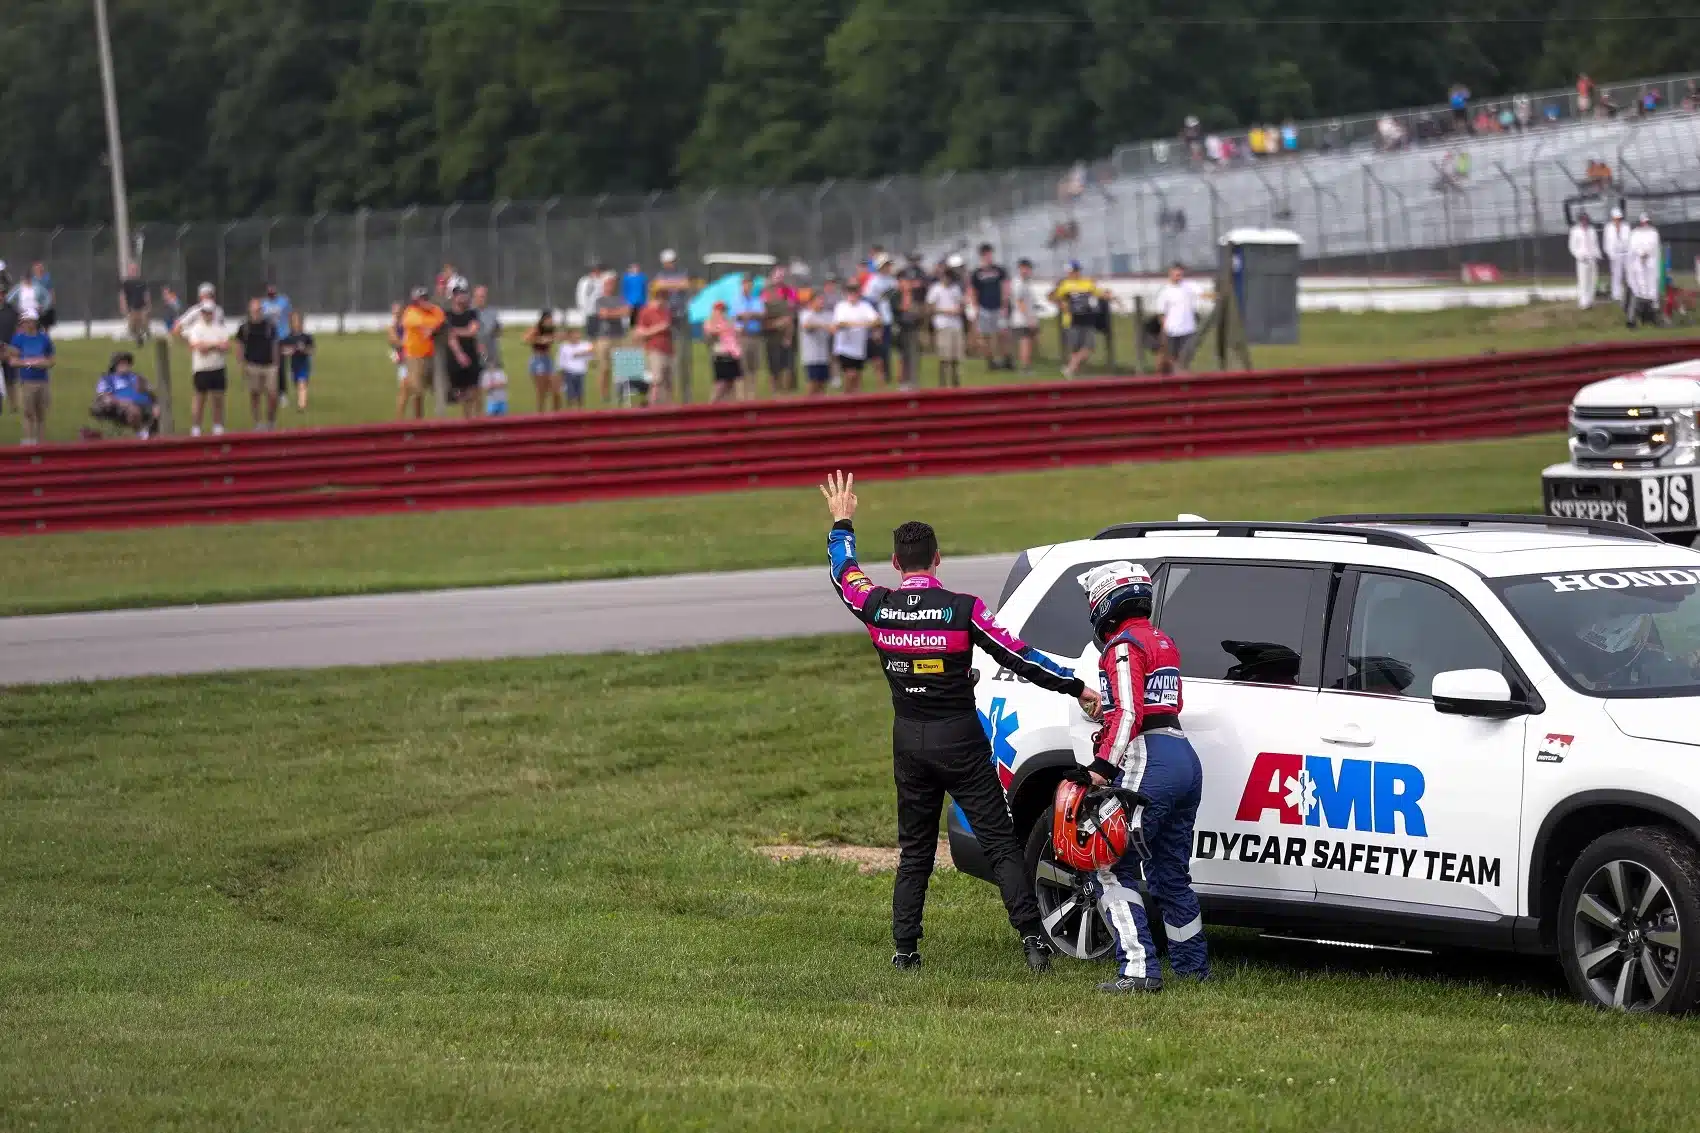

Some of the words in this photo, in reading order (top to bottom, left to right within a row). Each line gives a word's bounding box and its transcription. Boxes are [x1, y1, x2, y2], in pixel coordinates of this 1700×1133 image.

[1551, 500, 1629, 525] STEPP'S
[1641, 475, 1690, 524] B/S
[878, 632, 947, 647] AutoNation
[1235, 752, 1429, 838] AMR
[1190, 830, 1307, 867] DYCAR
[1312, 839, 1418, 878] SAFETY
[1423, 850, 1501, 887] TEAM
